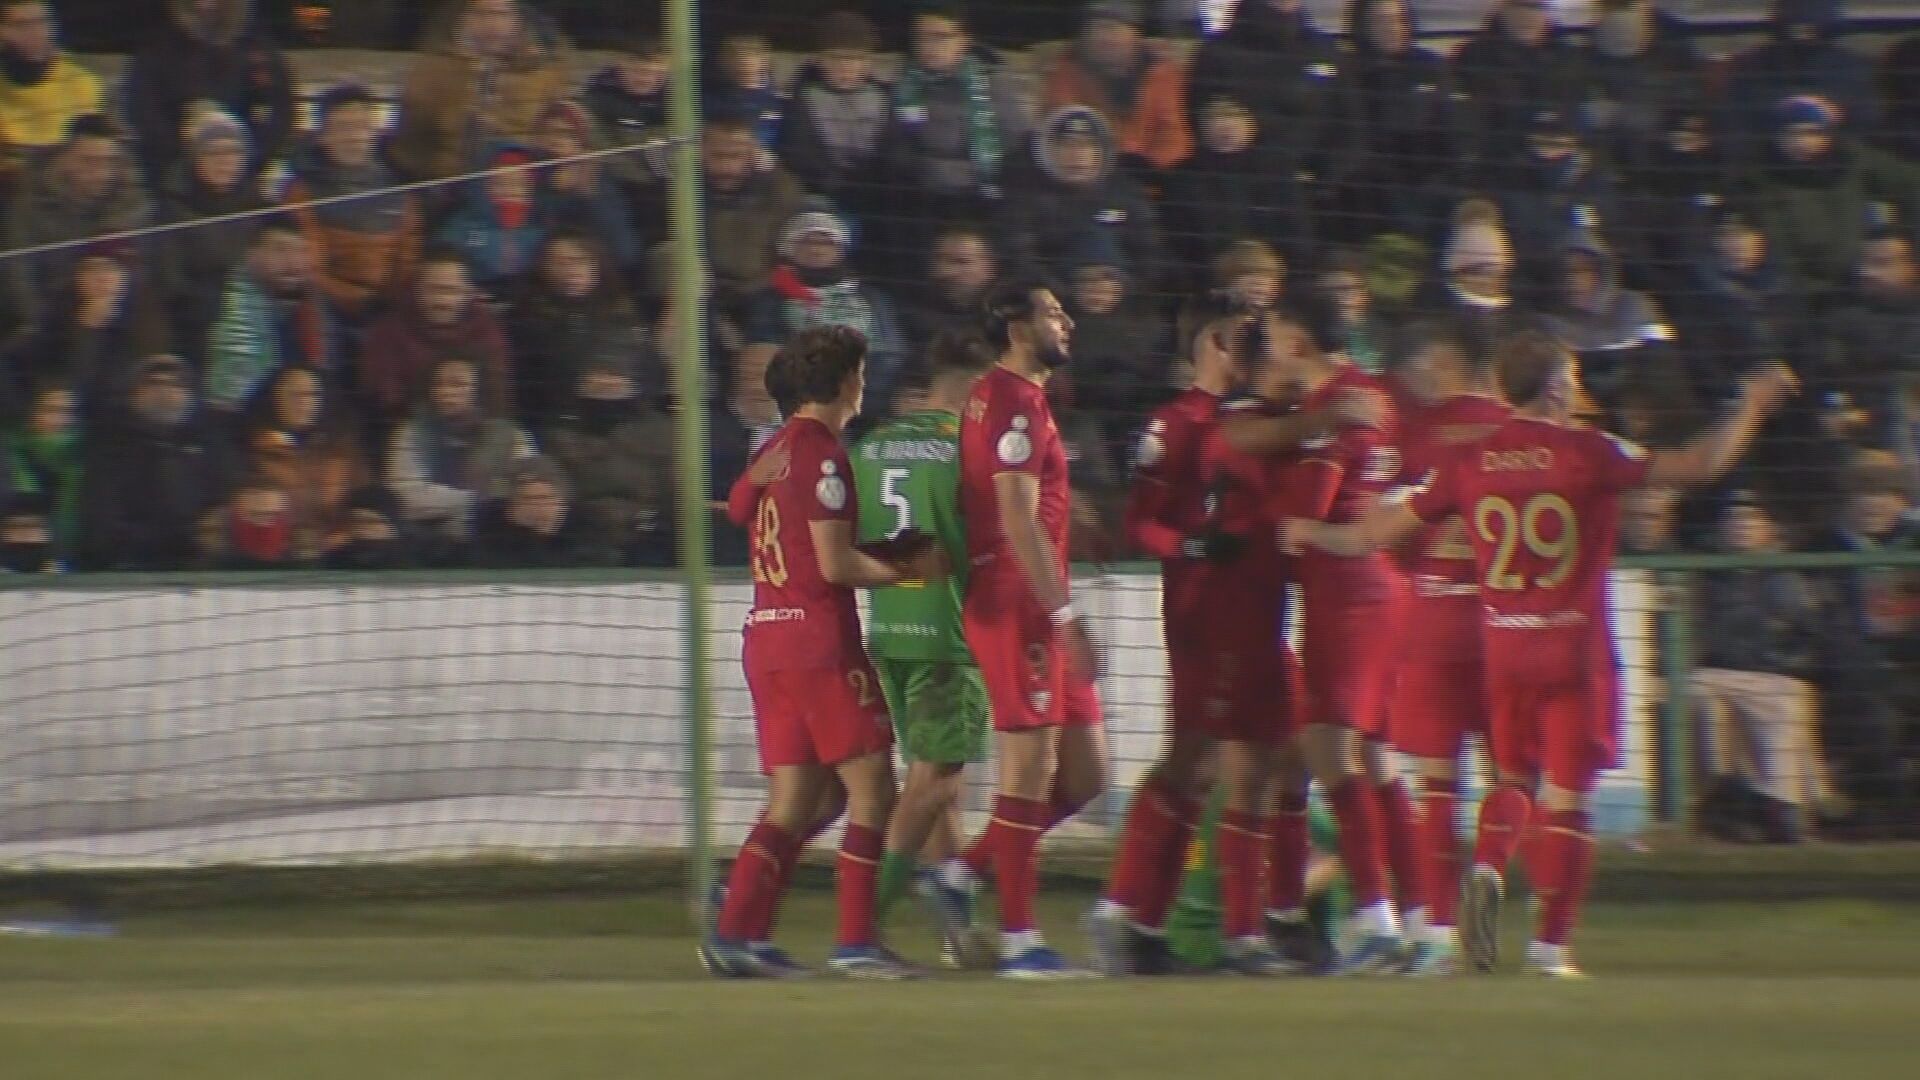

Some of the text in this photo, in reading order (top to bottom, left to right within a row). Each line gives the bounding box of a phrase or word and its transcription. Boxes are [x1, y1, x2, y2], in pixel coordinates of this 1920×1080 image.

[1480, 447, 1556, 472] DARIO
[880, 468, 911, 540] 5
[1475, 492, 1578, 590] 29
